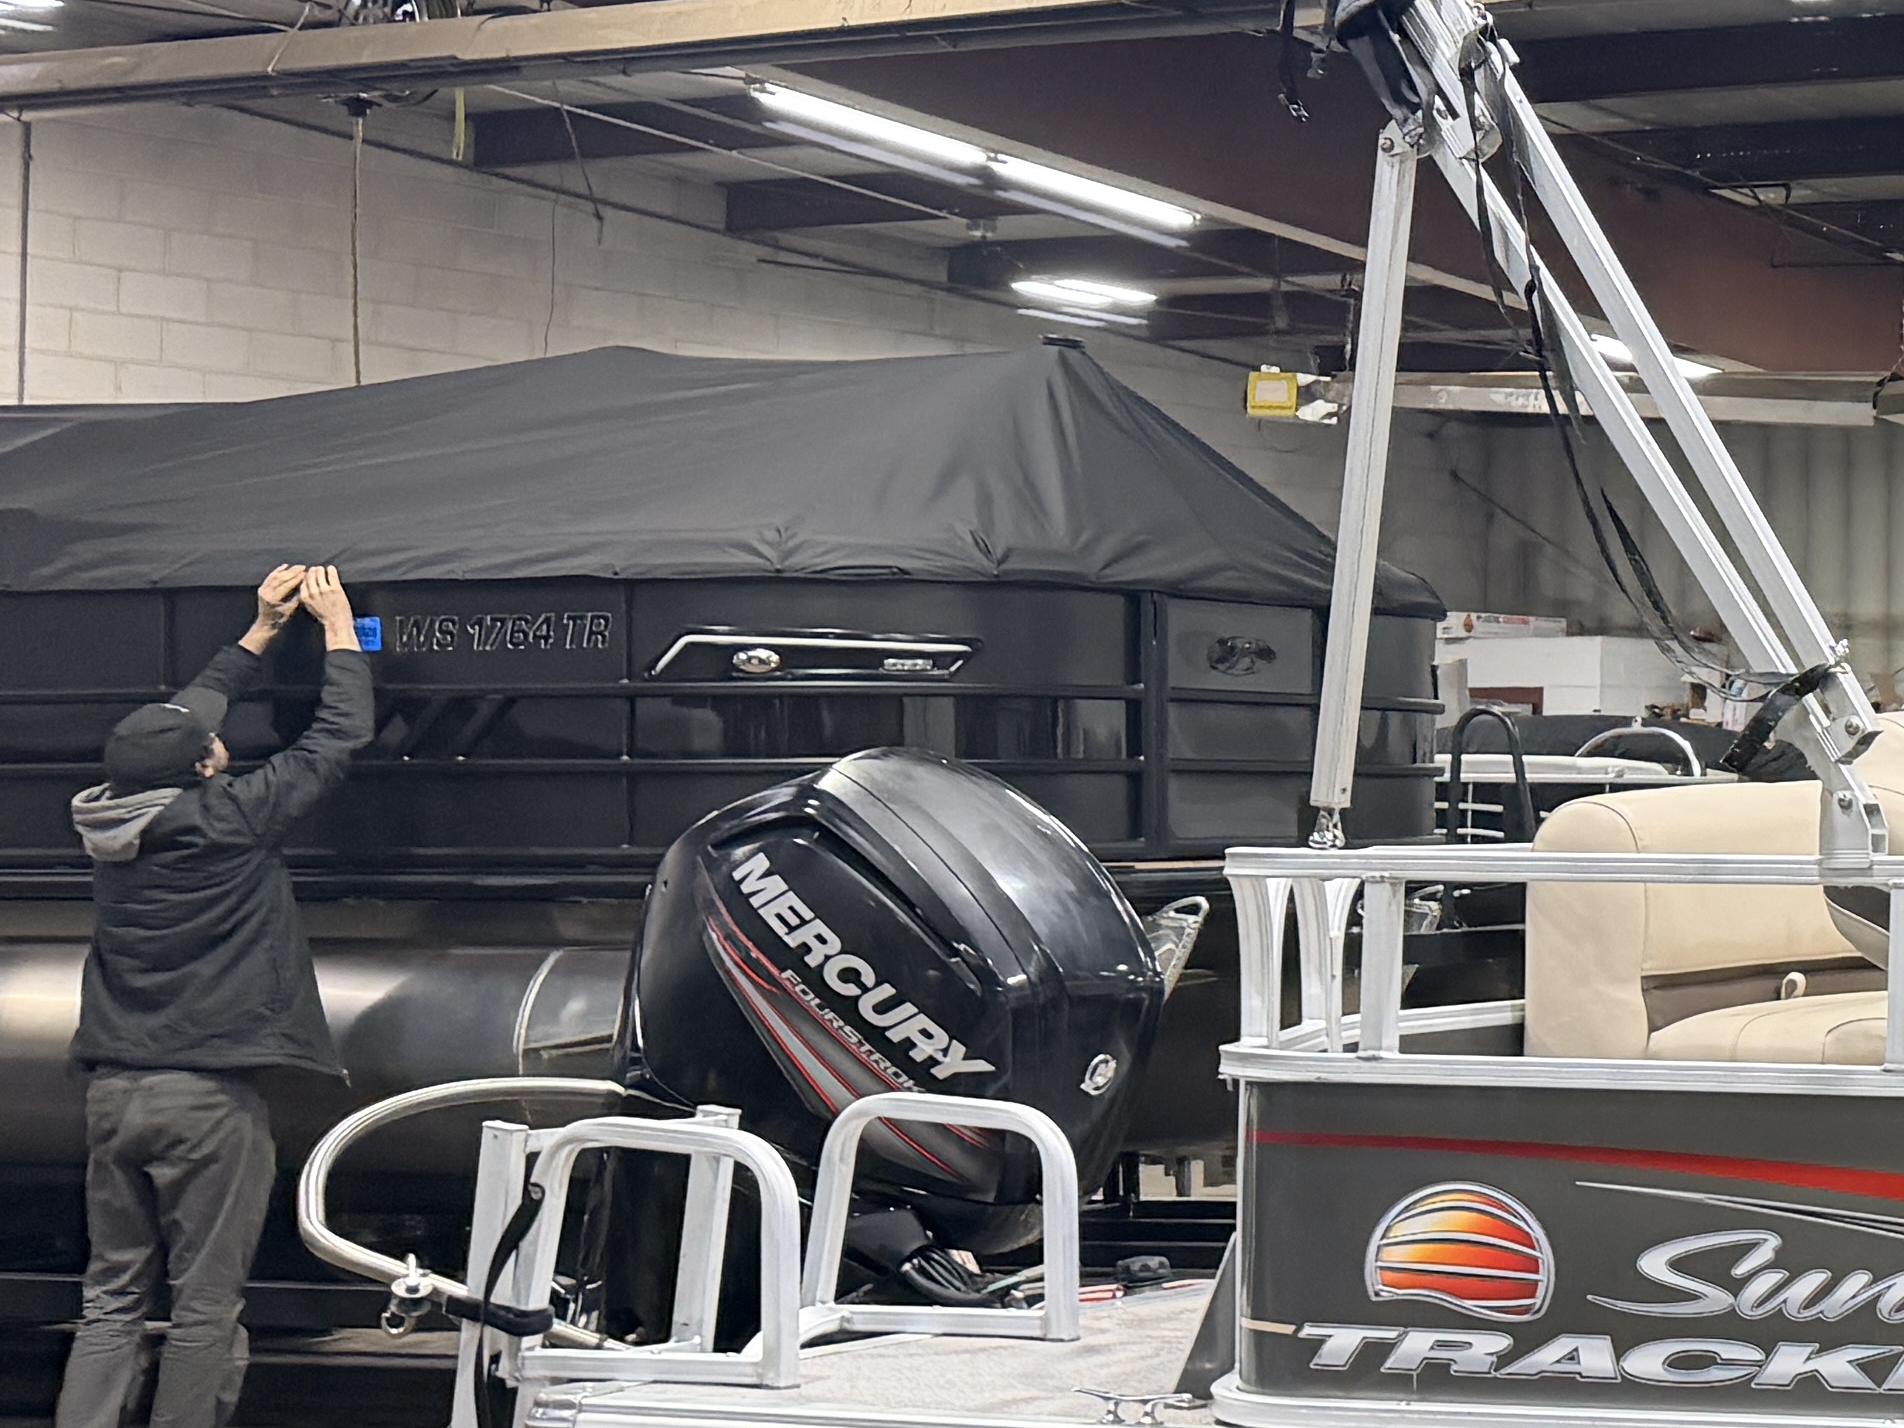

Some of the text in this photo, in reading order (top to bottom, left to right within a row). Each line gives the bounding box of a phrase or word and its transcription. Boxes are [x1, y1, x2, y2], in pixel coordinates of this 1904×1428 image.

[395, 615, 458, 652] WS
[467, 612, 555, 651] 1764
[564, 612, 612, 650] TR
[731, 852, 996, 1080] MERCURY
[781, 969, 926, 1092] FOURSTROK
